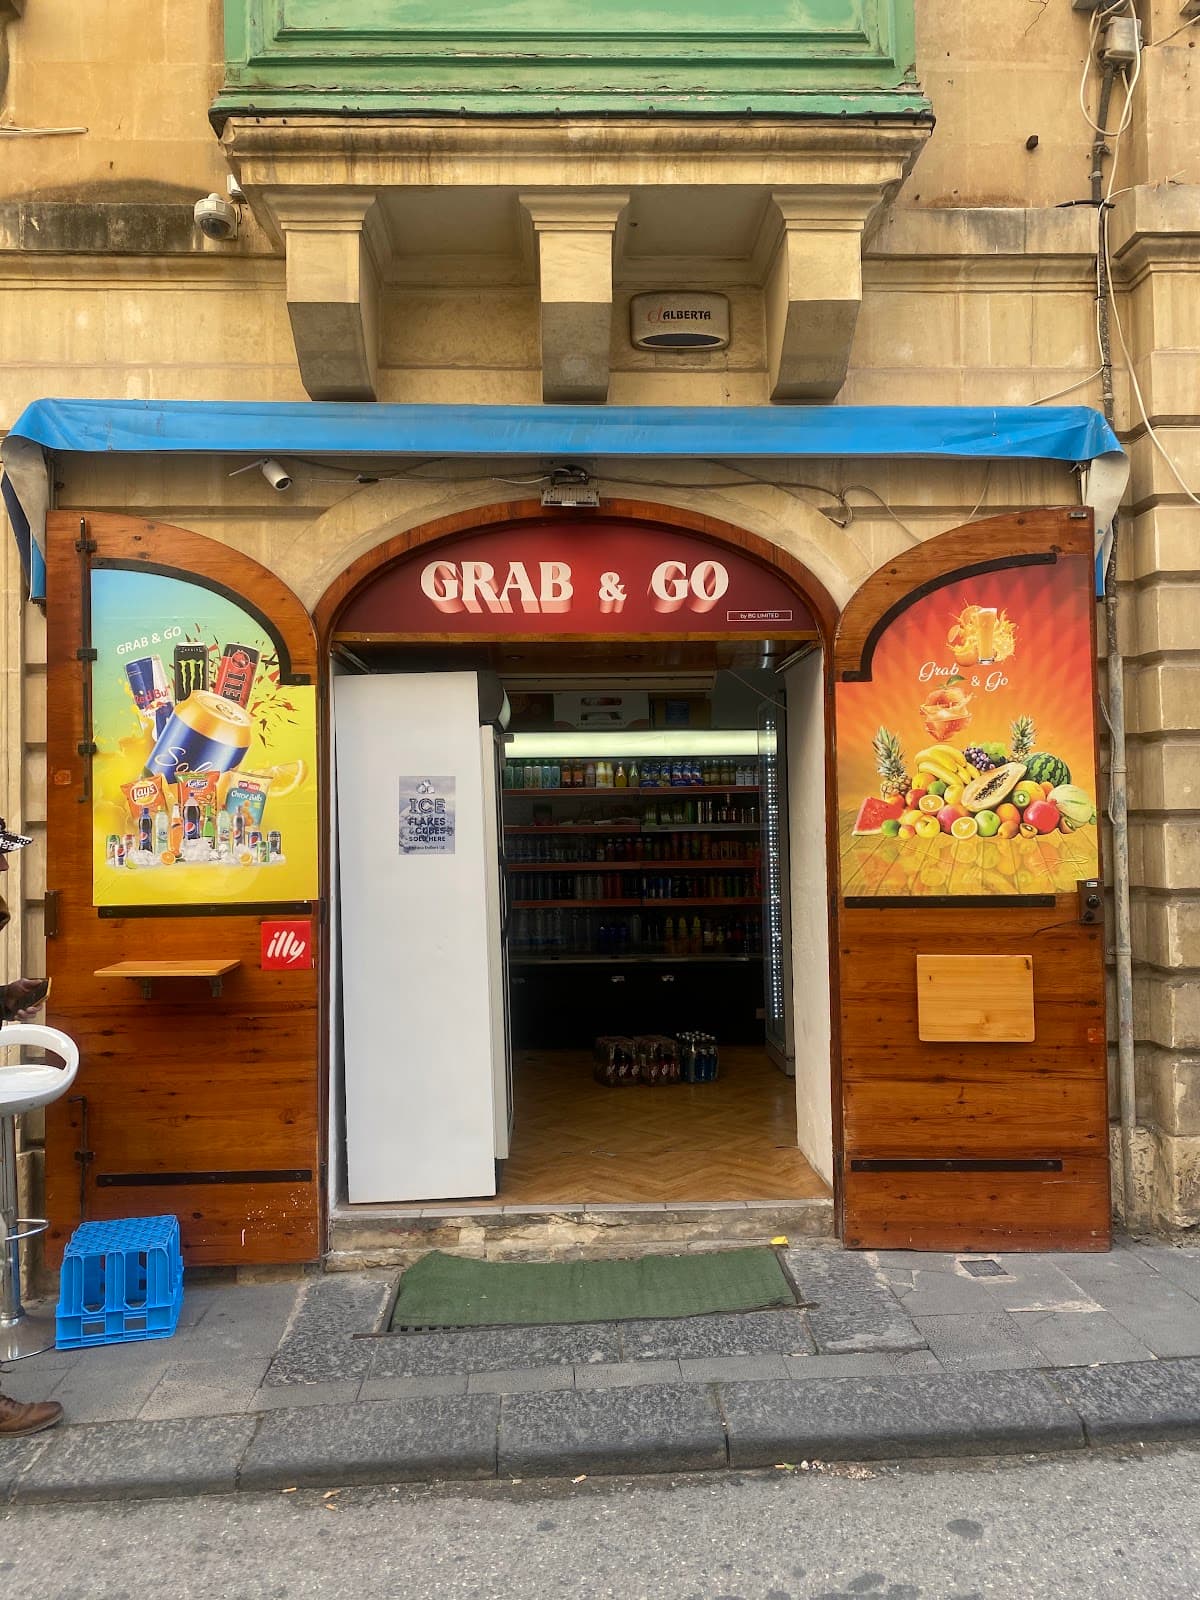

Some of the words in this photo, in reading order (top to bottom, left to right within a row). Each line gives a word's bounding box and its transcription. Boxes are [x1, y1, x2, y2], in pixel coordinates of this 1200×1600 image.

[420, 560, 574, 613] GRAB
[599, 571, 627, 613] &
[651, 560, 729, 613] GO
[116, 637, 149, 655] GRAB
[151, 633, 161, 644] &
[163, 626, 181, 640] GO
[918, 661, 960, 682] Grab
[970, 675, 980, 687] &
[984, 671, 1009, 692] Go
[409, 798, 446, 814] ICE
[409, 817, 446, 826] FLAKES
[267, 930, 306, 964] illy
